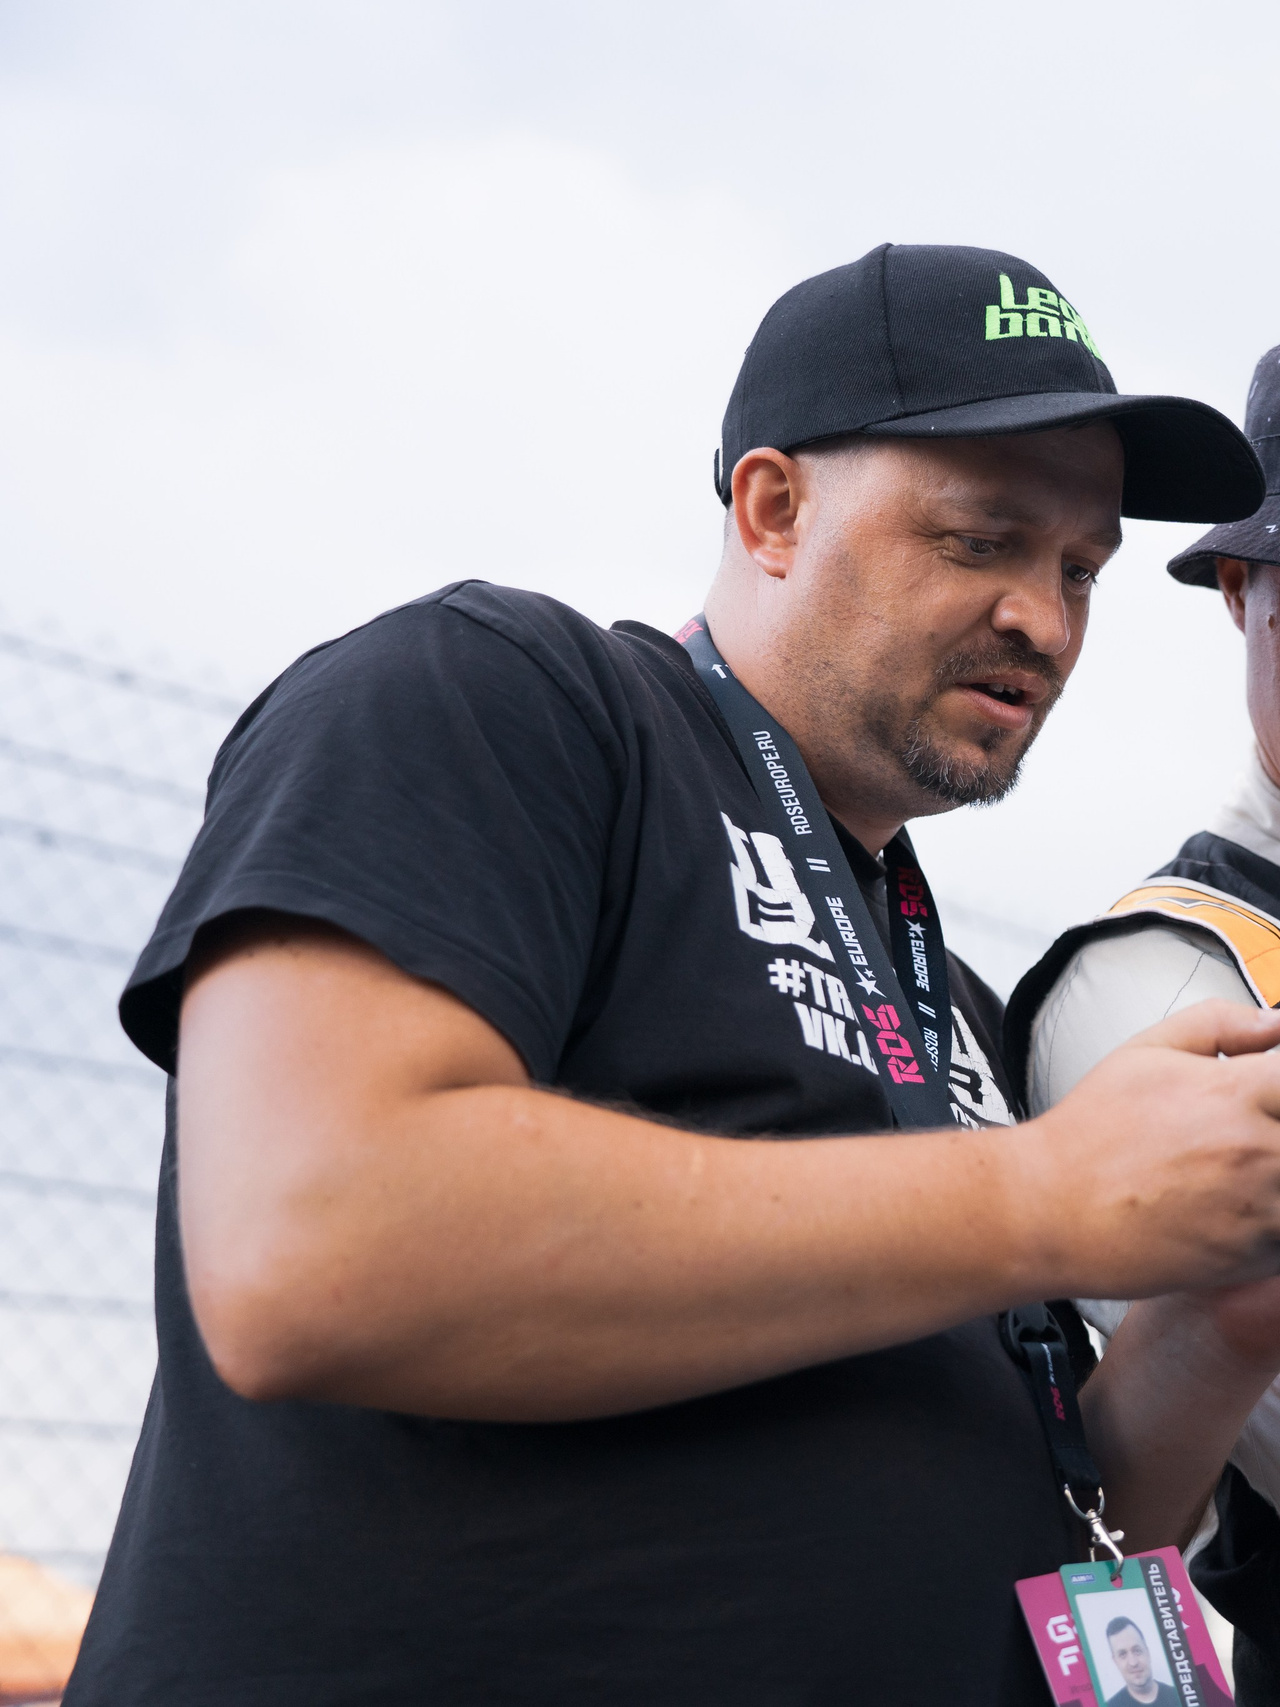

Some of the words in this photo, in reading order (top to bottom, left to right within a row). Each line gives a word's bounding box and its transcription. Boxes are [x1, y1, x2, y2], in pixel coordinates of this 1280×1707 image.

[752, 730, 813, 835] RDSEUROPE.RU
[825, 896, 869, 966] EUROPE
[910, 940, 930, 992] EUROPE
[861, 1003, 926, 1084] RDS
[1147, 1563, 1199, 1707] ПРЕДСТАВИТЕЛЬ
